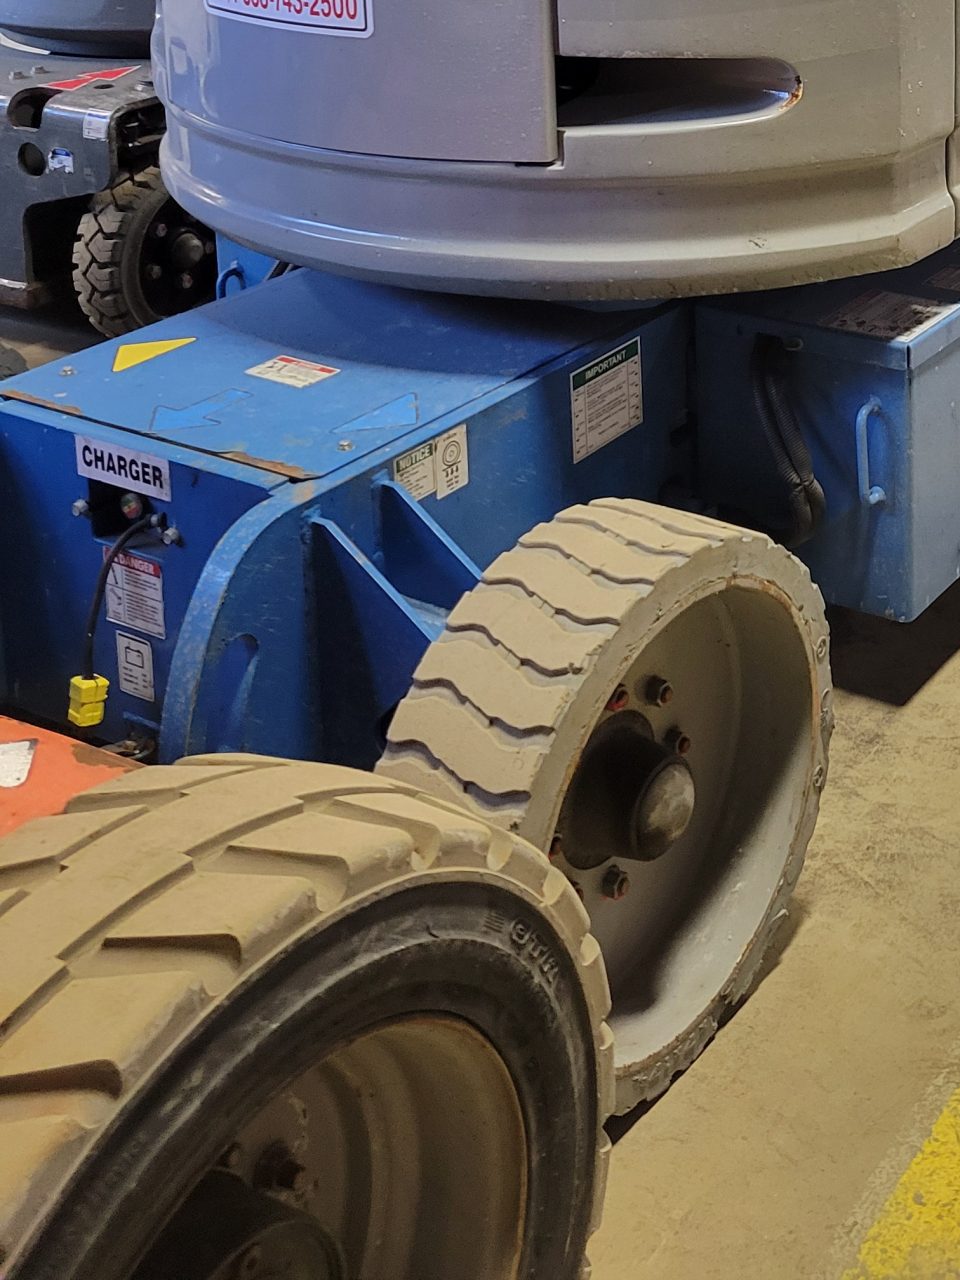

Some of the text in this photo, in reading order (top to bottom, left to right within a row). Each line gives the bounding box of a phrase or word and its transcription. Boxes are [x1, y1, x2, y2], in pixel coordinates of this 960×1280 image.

[585, 349, 627, 380] IMPORTANT
[82, 445, 164, 490] CHARGER
[399, 444, 431, 471] NOTICE
[118, 553, 155, 574] DANGER
